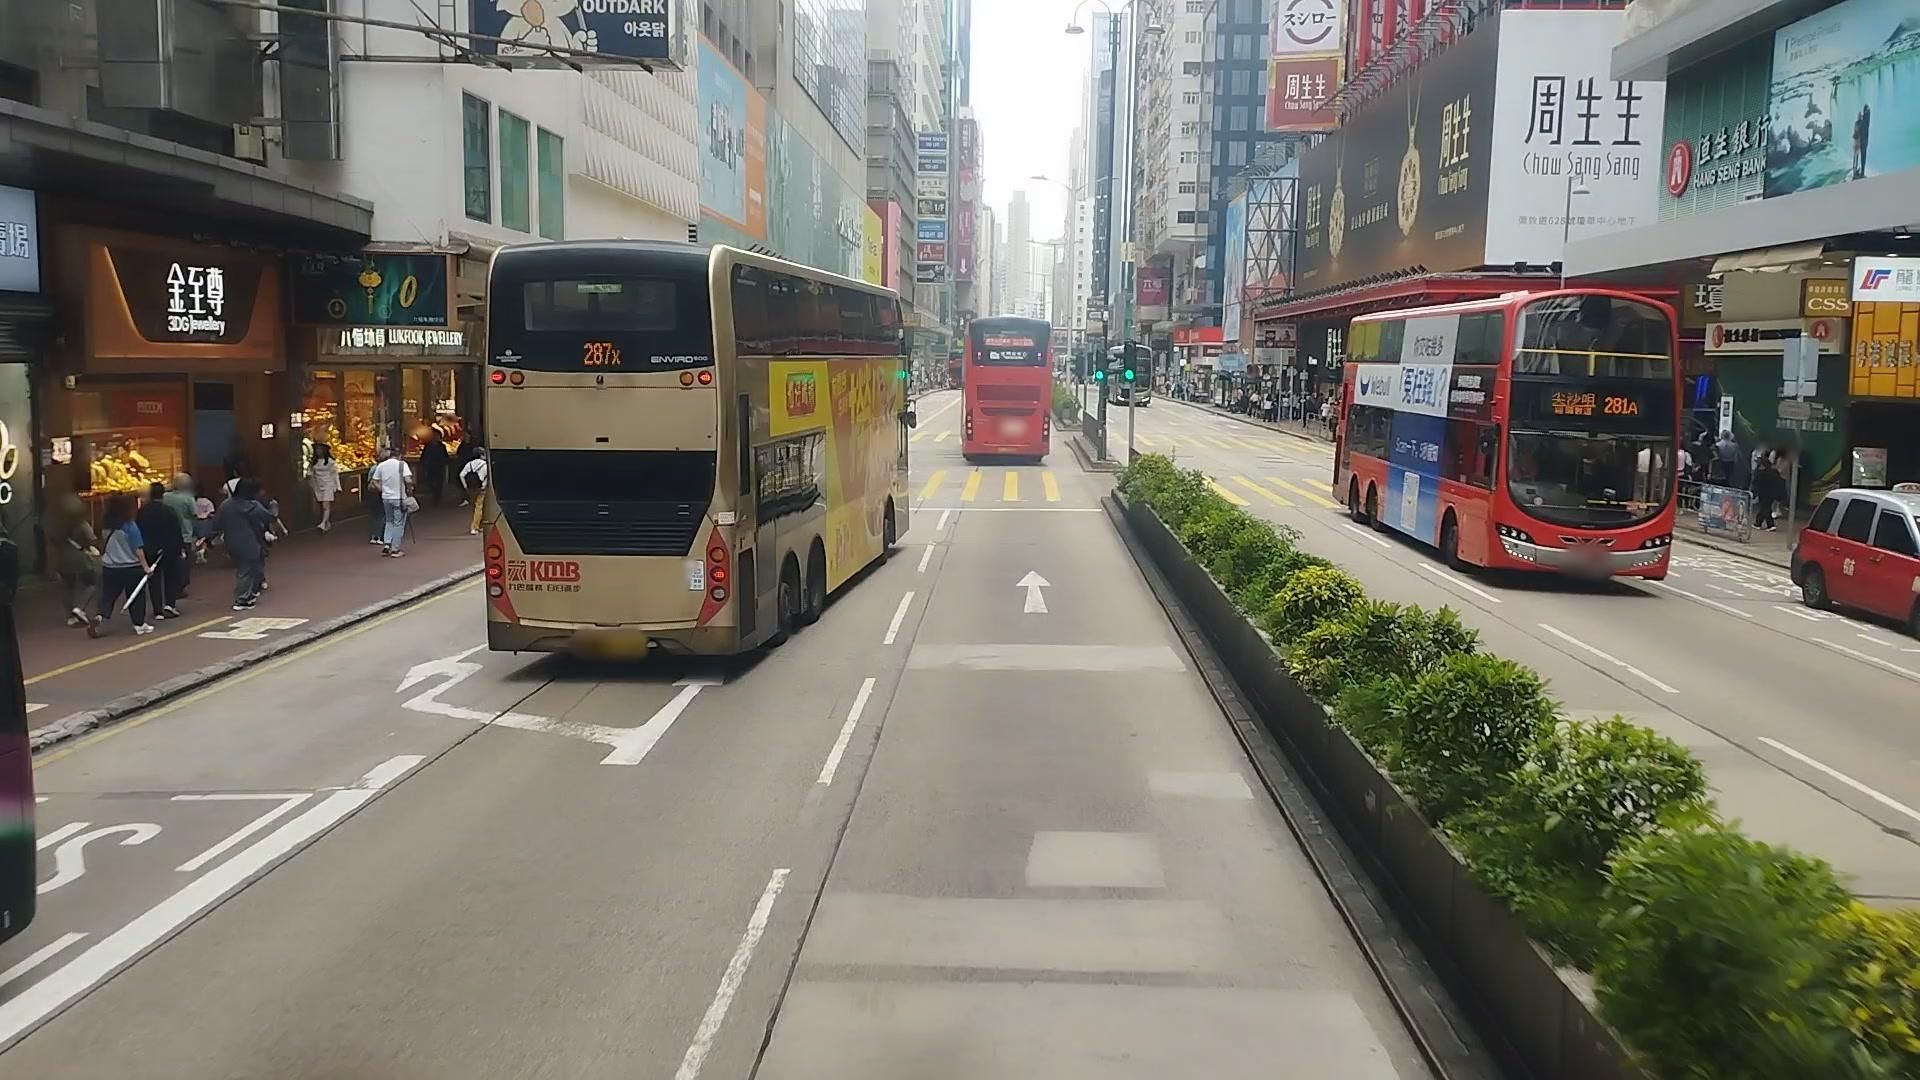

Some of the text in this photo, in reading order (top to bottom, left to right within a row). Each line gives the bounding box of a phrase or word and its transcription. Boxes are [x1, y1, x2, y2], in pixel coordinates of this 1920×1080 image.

[583, 0, 665, 14] OUTDARK
[623, 21, 665, 38] 아웃닭
[1283, 12, 1337, 26] スシロー
[1284, 73, 1326, 100] 周生生
[1524, 76, 1643, 146] 周生生
[1438, 94, 1472, 169] 周生生
[1695, 114, 1770, 165] 恒生銀行
[1523, 151, 1641, 181] Chow Sang Sang
[1694, 155, 1767, 188] HANG SENG BANK
[166, 262, 225, 316] 金至尊
[1807, 297, 1849, 311] CSS
[189, 316, 226, 337] Jewellery
[388, 329, 464, 347] LUKFOOK JEWELLERY
[1551, 391, 1596, 407] 尖沙咀
[1603, 396, 1638, 415] 281A
[530, 561, 581, 582] KMB
